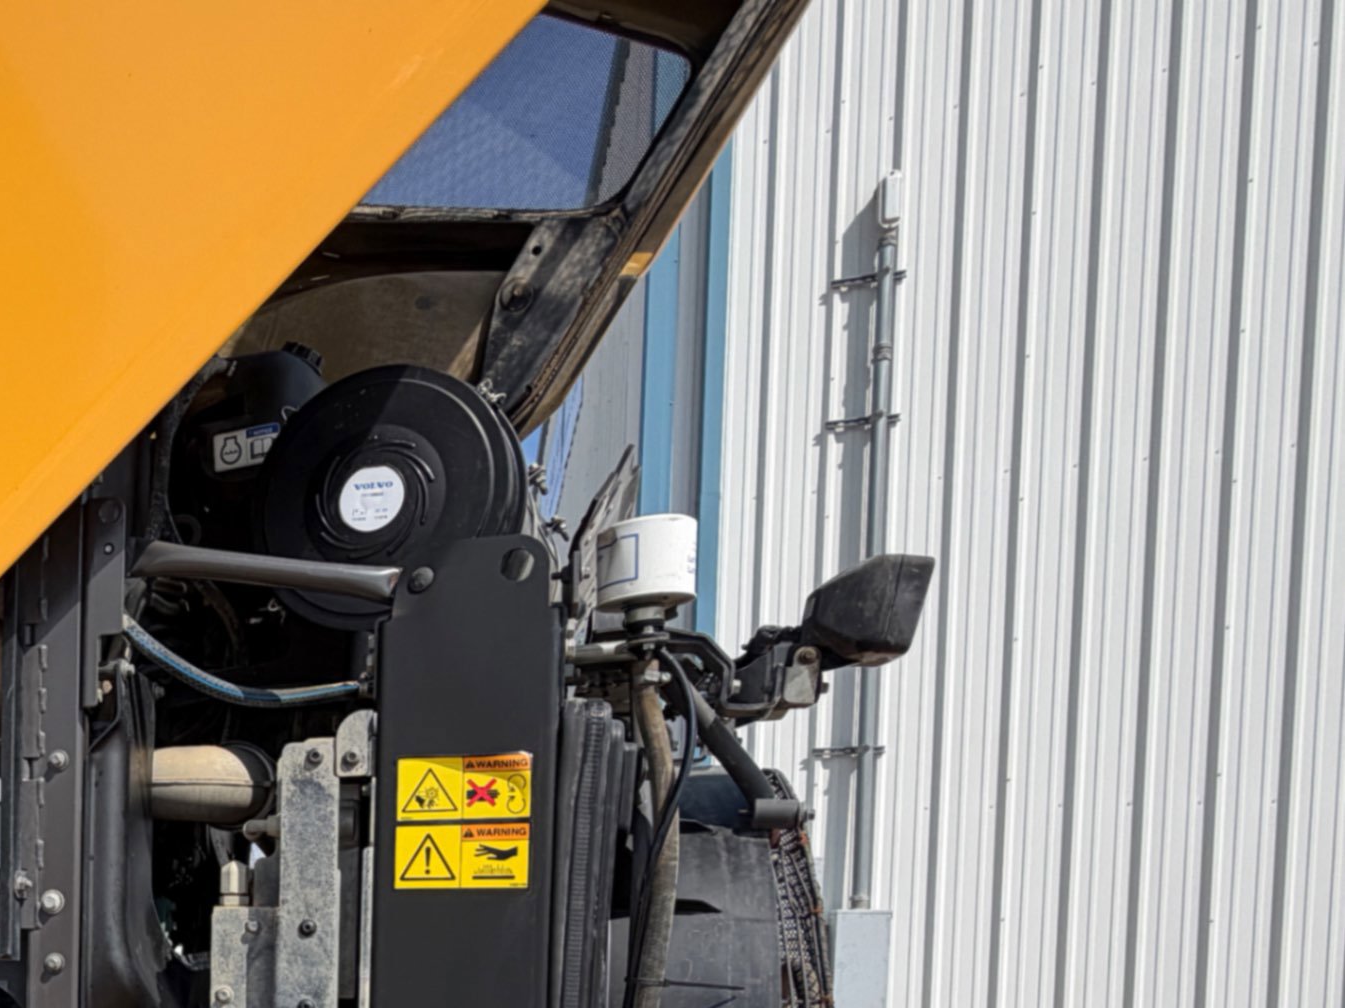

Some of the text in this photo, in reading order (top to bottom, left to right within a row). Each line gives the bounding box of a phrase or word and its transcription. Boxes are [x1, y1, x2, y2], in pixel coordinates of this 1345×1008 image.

[353, 480, 394, 490] VOLVO
[475, 758, 528, 769] WARNING
[476, 827, 527, 837] WARNING
